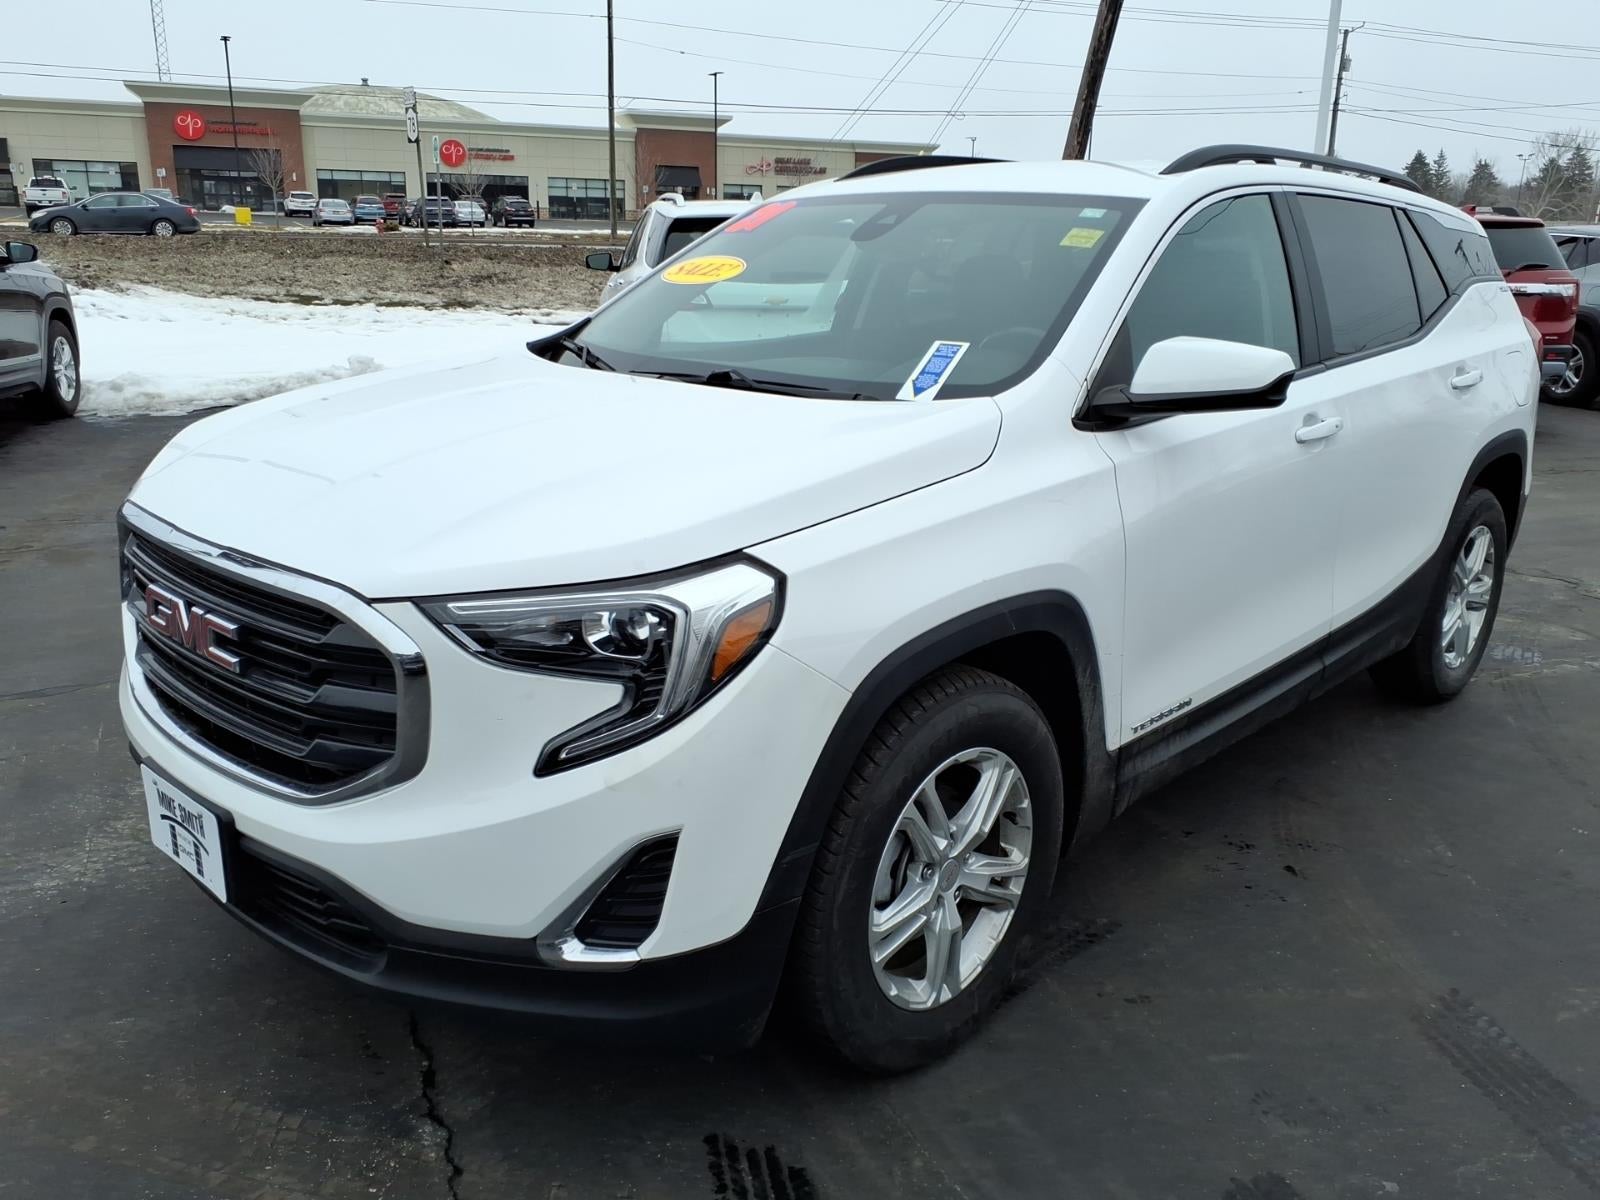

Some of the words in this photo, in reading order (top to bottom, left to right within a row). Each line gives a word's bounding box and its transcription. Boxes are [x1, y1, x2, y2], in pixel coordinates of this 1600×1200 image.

[145, 584, 240, 674] GMC
[156, 787, 178, 818] MIKE
[178, 802, 206, 839] SMITH
